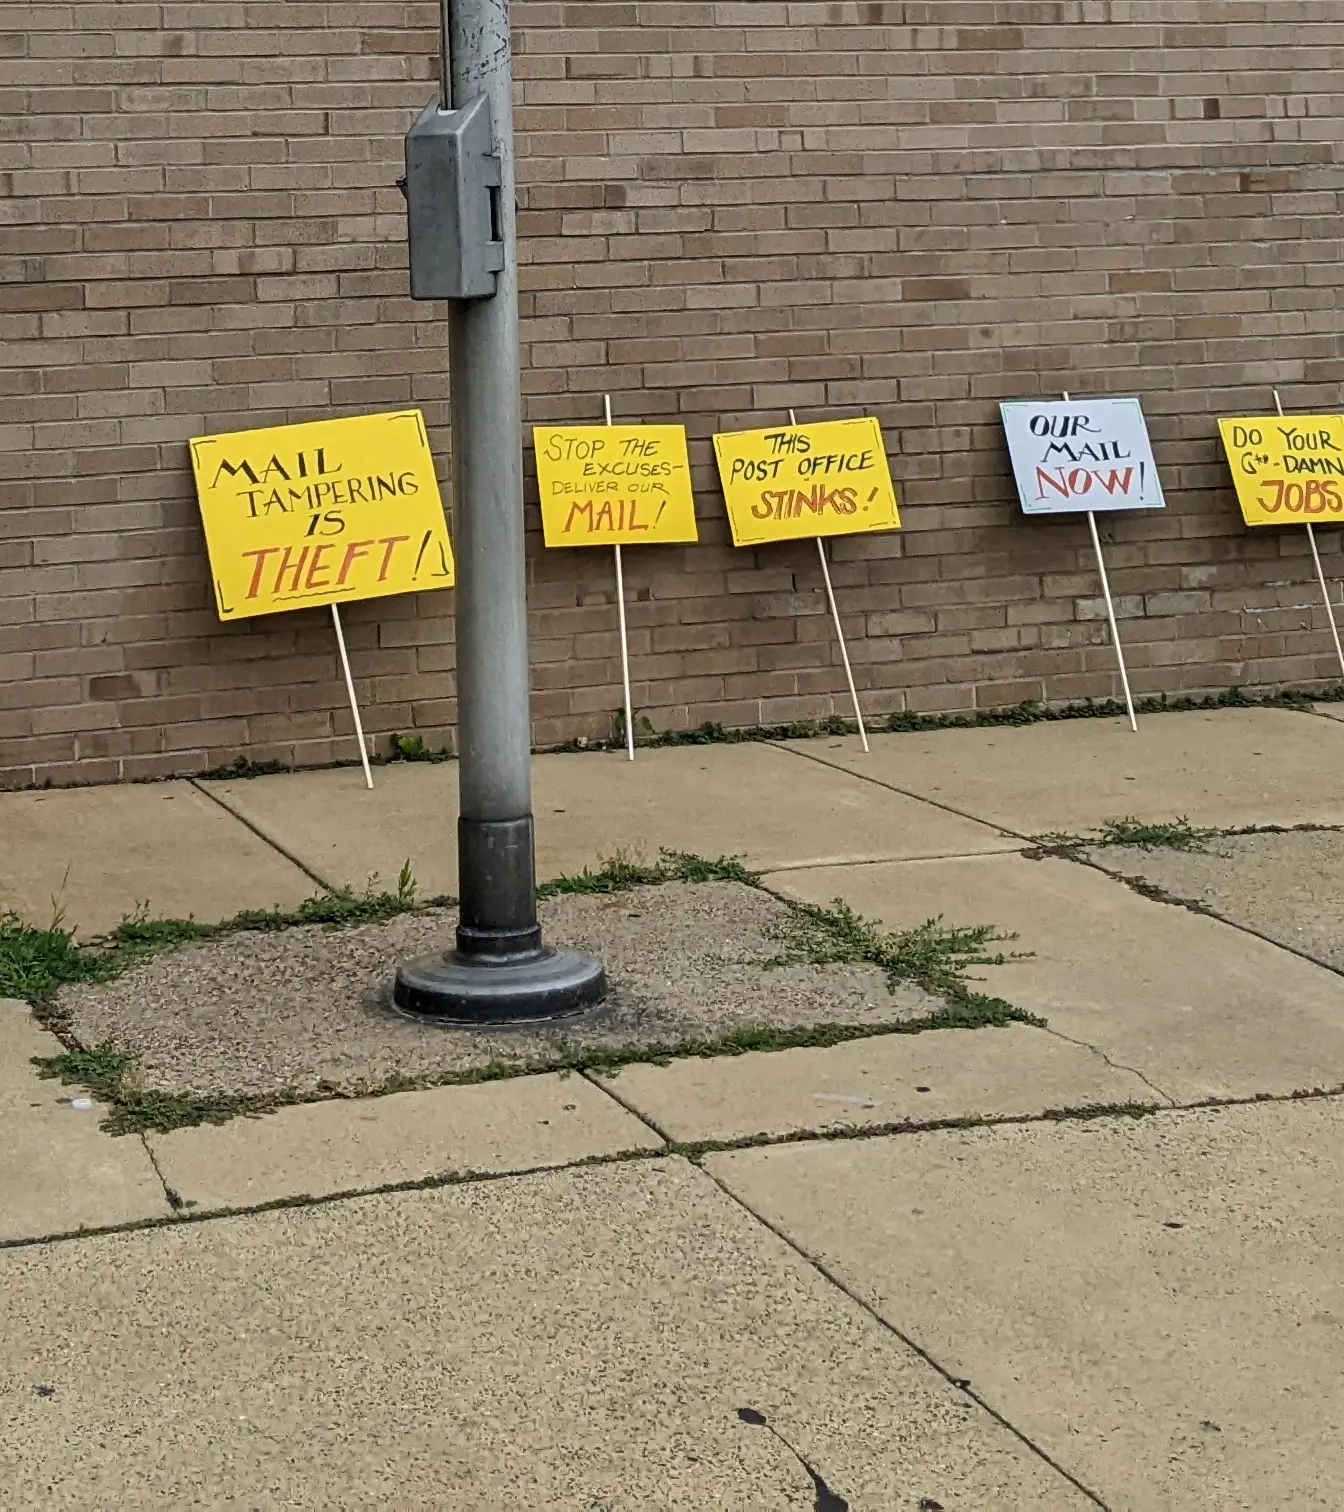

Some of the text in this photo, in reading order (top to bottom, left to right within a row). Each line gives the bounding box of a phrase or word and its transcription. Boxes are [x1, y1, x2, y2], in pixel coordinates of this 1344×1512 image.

[1029, 415, 1102, 438] OUR
[1233, 425, 1343, 452] DO YOUR
[543, 433, 661, 462] STOP THE
[763, 432, 811, 455] THIS
[1040, 440, 1131, 463] MAIL
[207, 447, 343, 490] MAIL
[730, 449, 876, 486] POST OFFICE
[1034, 461, 1145, 501] NOW!
[235, 471, 419, 518] TAMPERING
[551, 480, 670, 495] DELIVER OUR
[750, 483, 879, 521] STINKS!
[303, 509, 346, 538] IS
[560, 499, 667, 534] MAIL!
[241, 529, 432, 600] THEFT!
